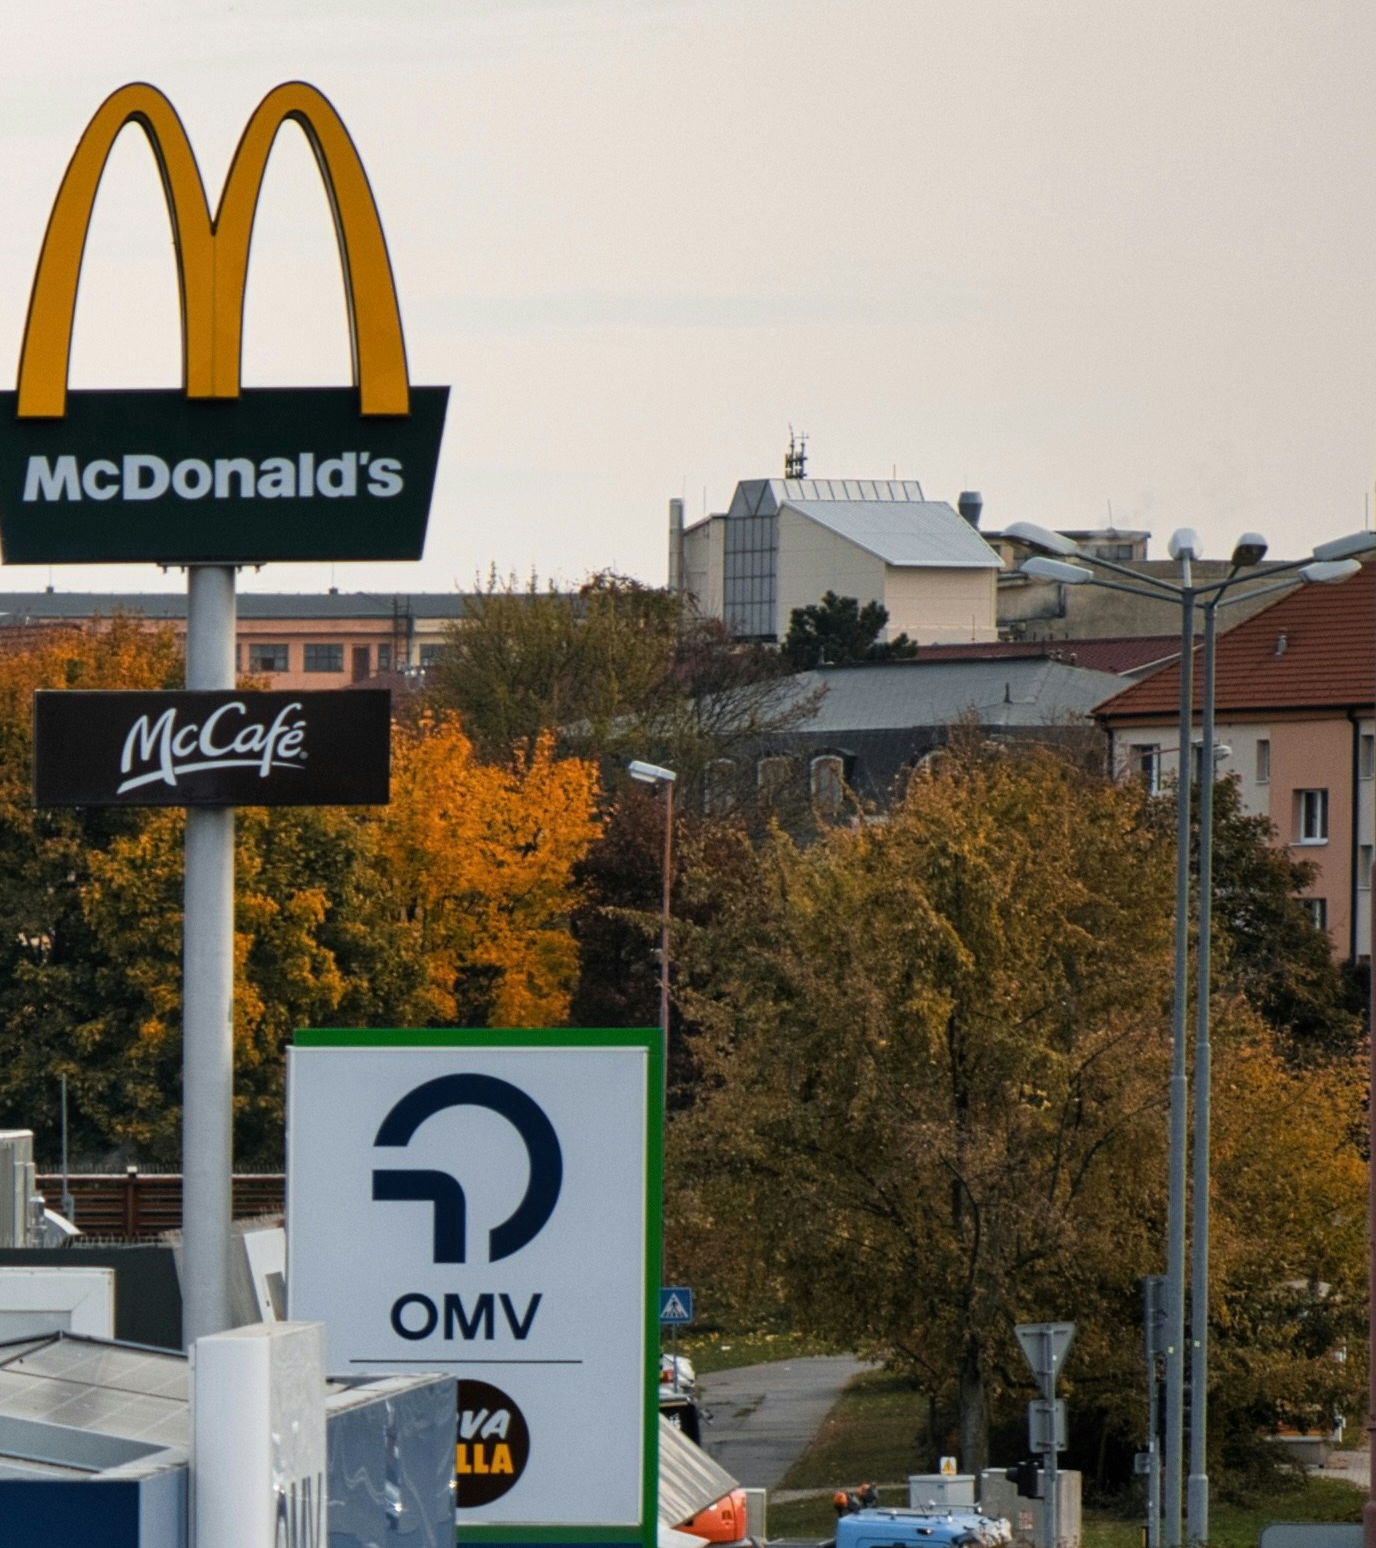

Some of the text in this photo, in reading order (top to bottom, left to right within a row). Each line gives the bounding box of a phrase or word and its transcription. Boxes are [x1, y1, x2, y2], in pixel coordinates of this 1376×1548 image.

[22, 452, 404, 502] McDonald's
[118, 701, 308, 787] McCafé
[390, 1292, 543, 1341] OMV
[456, 1408, 511, 1439] VA
[455, 1443, 514, 1474] LLA
